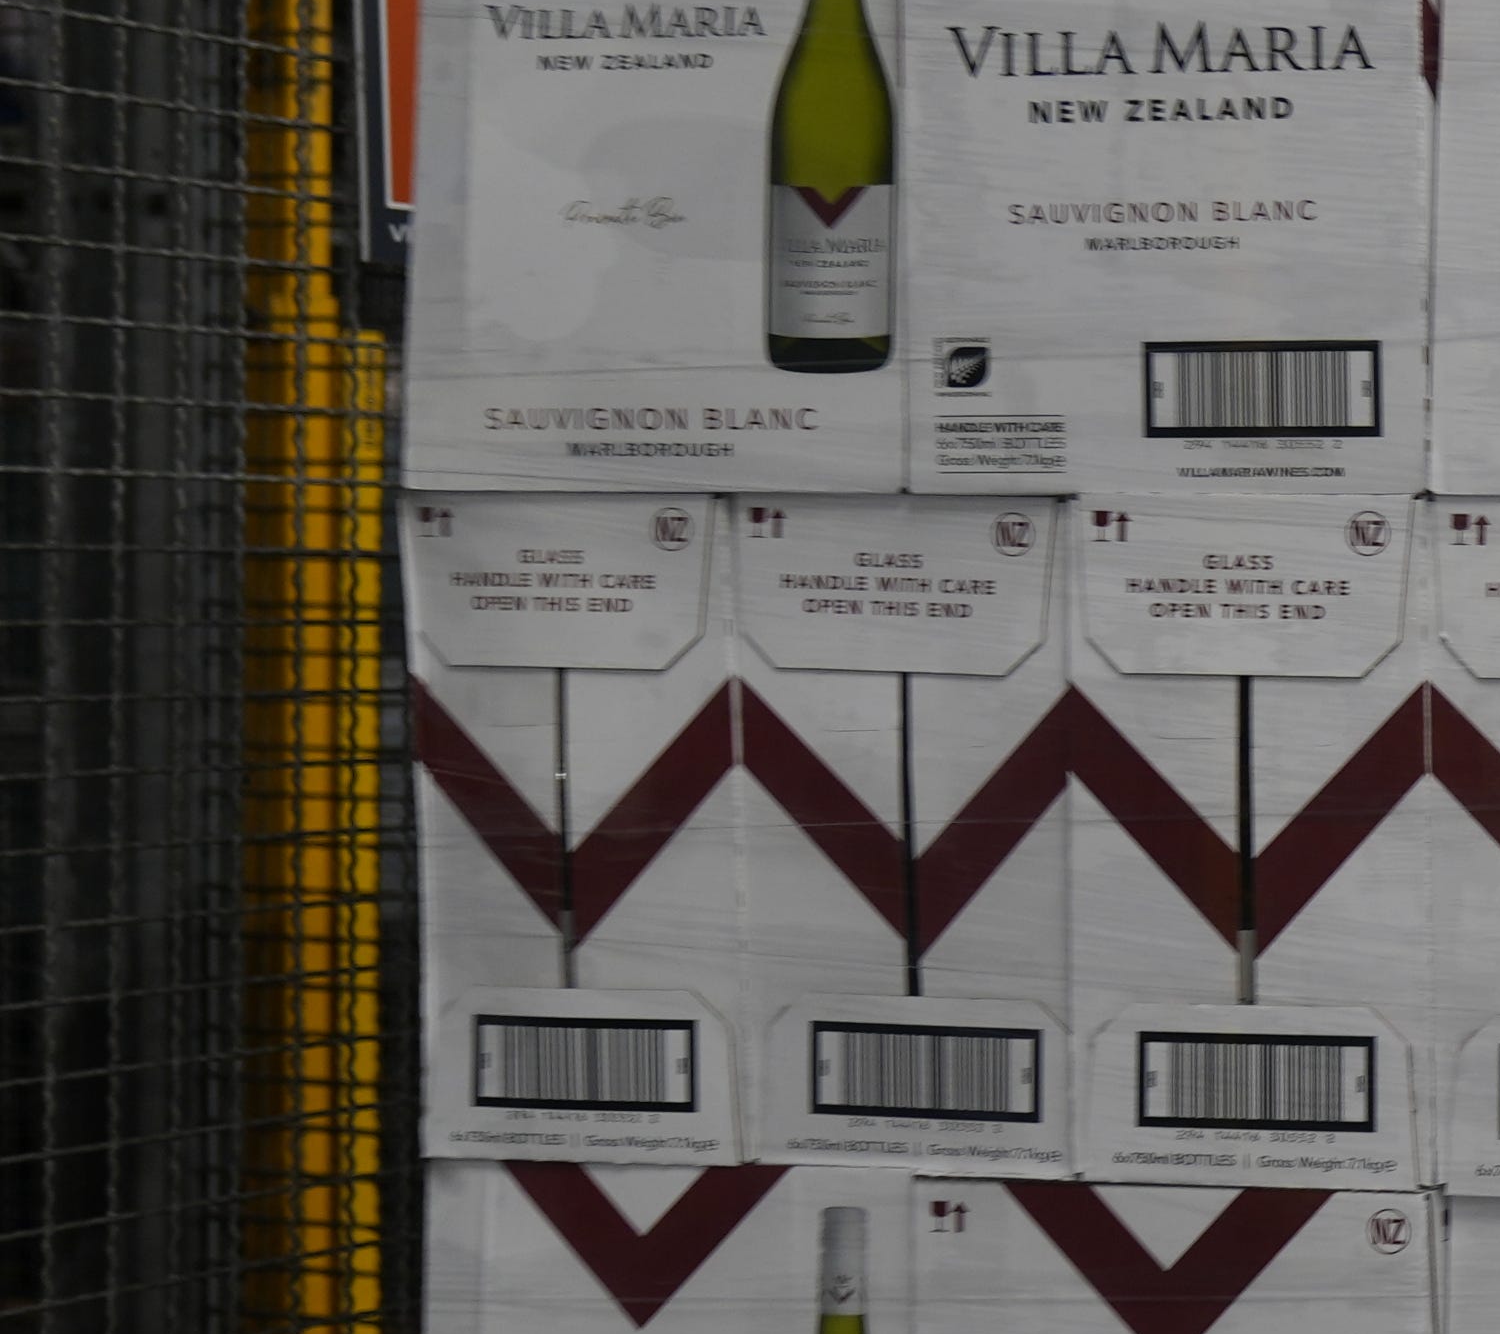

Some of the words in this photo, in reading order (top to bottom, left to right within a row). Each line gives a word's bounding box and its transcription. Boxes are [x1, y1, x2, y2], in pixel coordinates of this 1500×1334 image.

[946, 26, 1137, 76] VILLA
[1149, 23, 1375, 74] MARIA
[1030, 101, 1107, 123] NEW
[1126, 97, 1291, 122] ZEALAND
[1009, 202, 1197, 225] SAUVIGNON
[1213, 200, 1317, 221] BLANC
[1371, 1215, 1406, 1249] NZ
